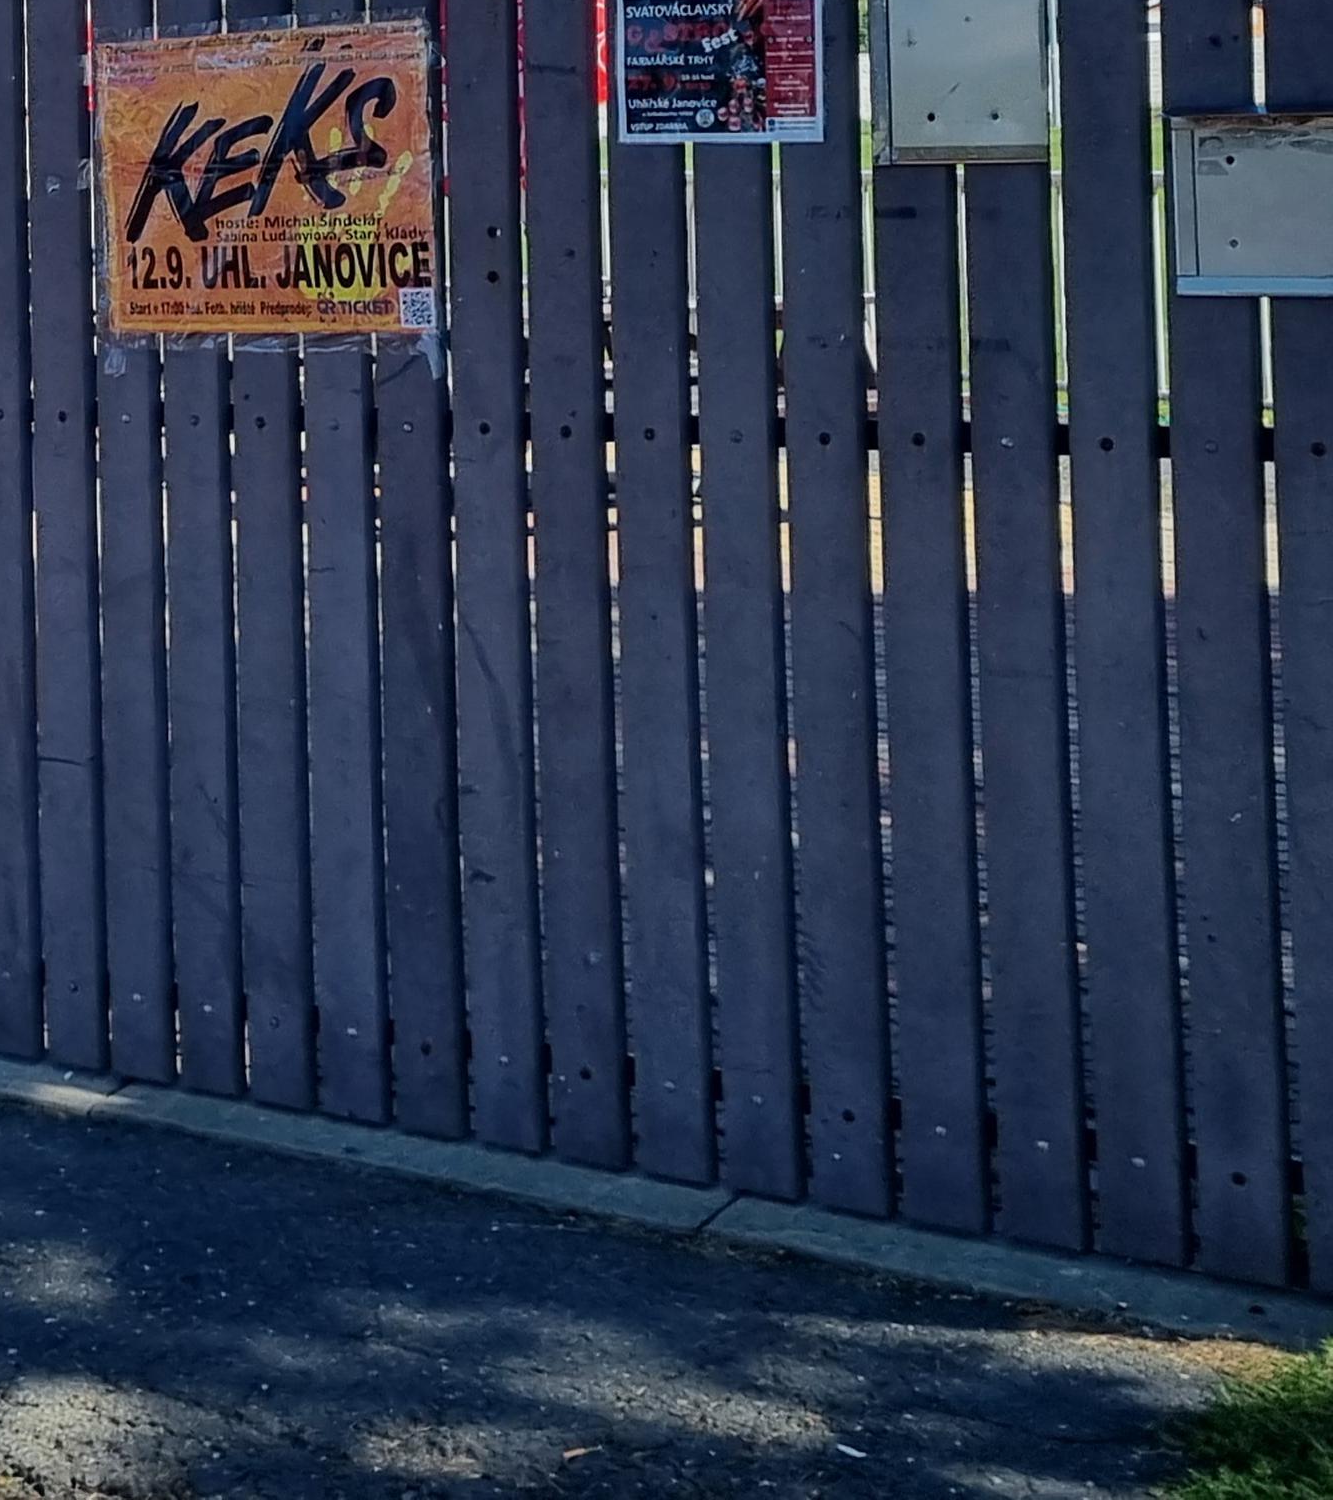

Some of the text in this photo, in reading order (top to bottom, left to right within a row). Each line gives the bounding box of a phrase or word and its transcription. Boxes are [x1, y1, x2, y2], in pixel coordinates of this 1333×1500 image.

[124, 60, 398, 243] KEKS
[264, 216, 316, 229] Michal
[216, 230, 258, 242] Sabina
[127, 240, 433, 290] 12.9. UHL. JANOVICE
[338, 299, 395, 315] TICKET
